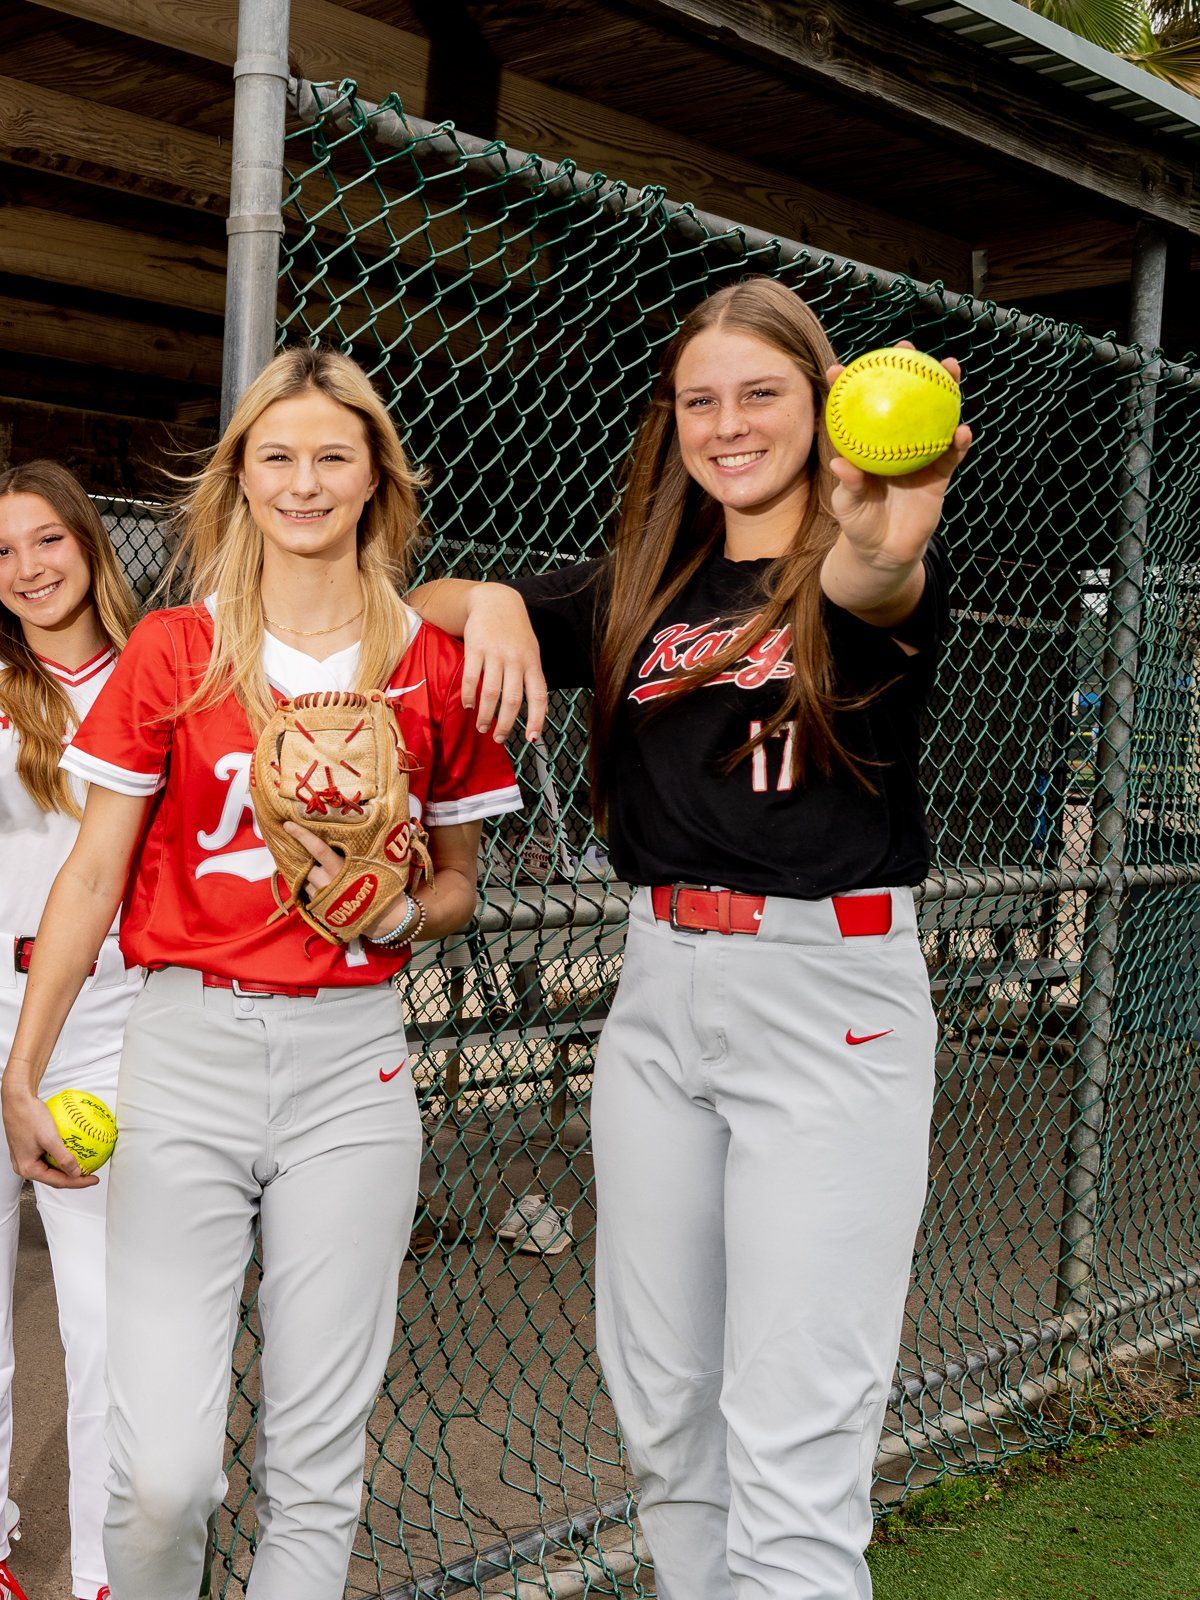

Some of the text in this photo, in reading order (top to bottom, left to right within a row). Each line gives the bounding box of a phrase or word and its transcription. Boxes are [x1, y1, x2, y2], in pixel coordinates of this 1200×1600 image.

[639, 614, 795, 690] Katy
[750, 720, 797, 792] 17
[327, 876, 375, 926] Wilson
